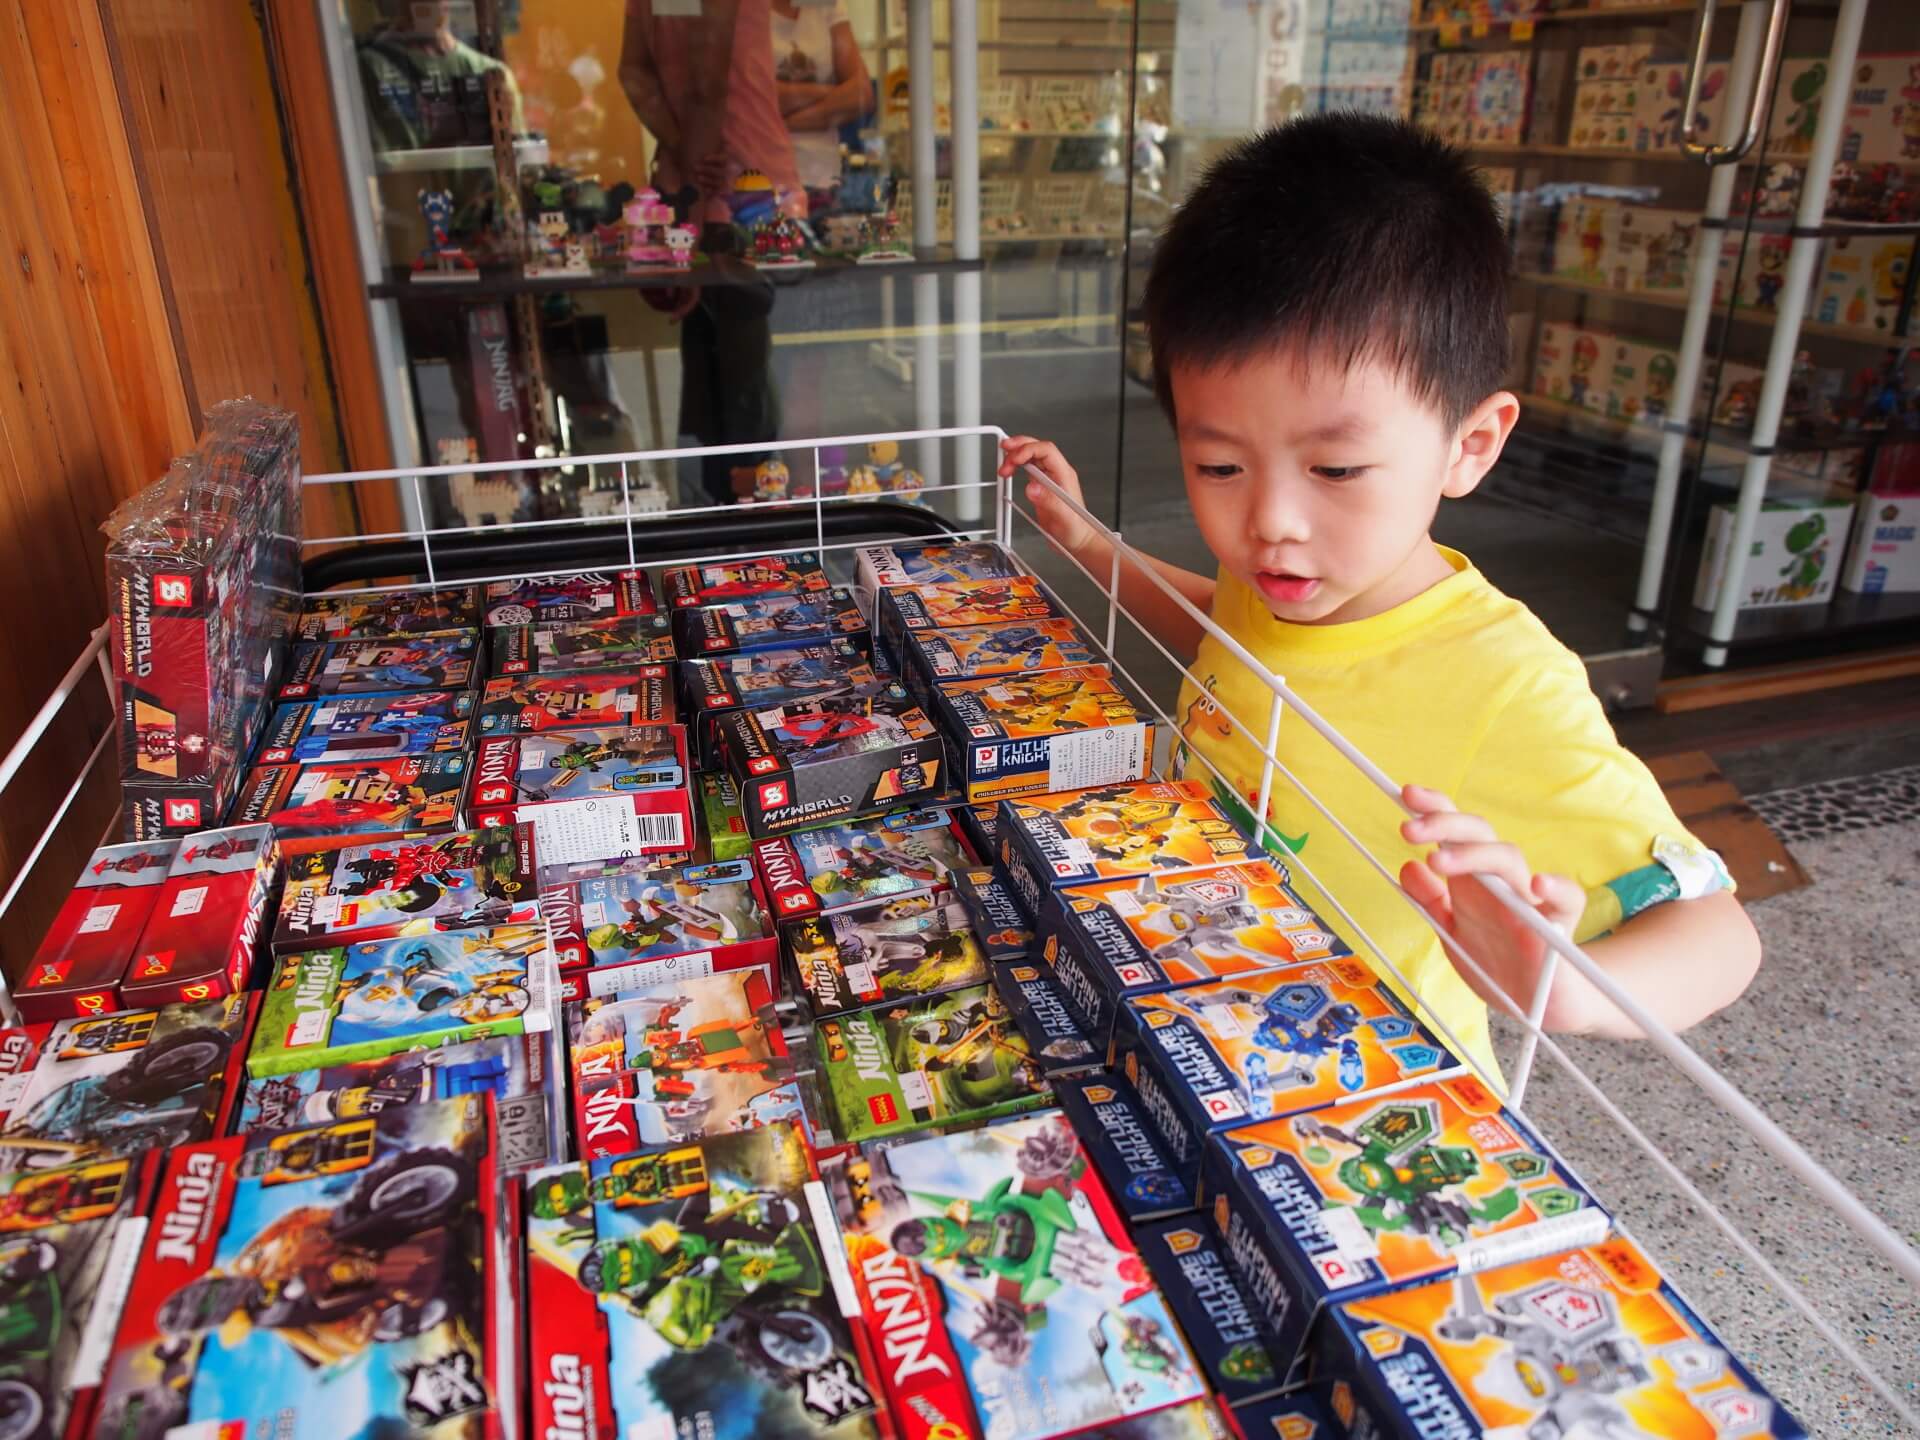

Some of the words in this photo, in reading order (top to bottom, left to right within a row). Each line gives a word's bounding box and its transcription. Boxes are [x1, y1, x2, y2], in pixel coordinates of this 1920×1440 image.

[521, 712, 532, 729] 5-12
[629, 727, 642, 742] 5-12
[406, 759, 422, 776] 5-12
[1002, 749, 1050, 767] KNIGHT
[242, 767, 280, 822] MYWORLD
[762, 795, 853, 823] MYWORLD
[520, 851, 530, 875] General
[760, 839, 804, 892] NINJA
[1023, 818, 1060, 864] FUTURE
[289, 886, 314, 934] Ninja
[592, 880, 607, 899] 5-12
[974, 884, 1006, 929] FUTURE
[990, 883, 1024, 927] KNIGHTS
[1078, 912, 1126, 968] FUTURE
[1095, 910, 1140, 962] KNIGHTS
[294, 953, 335, 1010] Ninja
[812, 959, 843, 1009] Ninja
[1037, 980, 1079, 1035] KNIGHTS
[1020, 981, 1061, 1038] FUTURE
[847, 1021, 892, 1083] Ninja
[1154, 1028, 1207, 1094] FUTURE
[1172, 1023, 1228, 1090] KNIGHTS
[1093, 1105, 1143, 1174] FUTURE
[1111, 1101, 1165, 1171] KNIGHTS
[155, 1151, 217, 1265] Ninja
[1252, 1169, 1322, 1253] FUTURE
[861, 1249, 951, 1387] NINJA
[1178, 1255, 1246, 1344] FUTURE
[1199, 1249, 1259, 1339] KNIGHTS
[543, 1352, 586, 1440] inja
